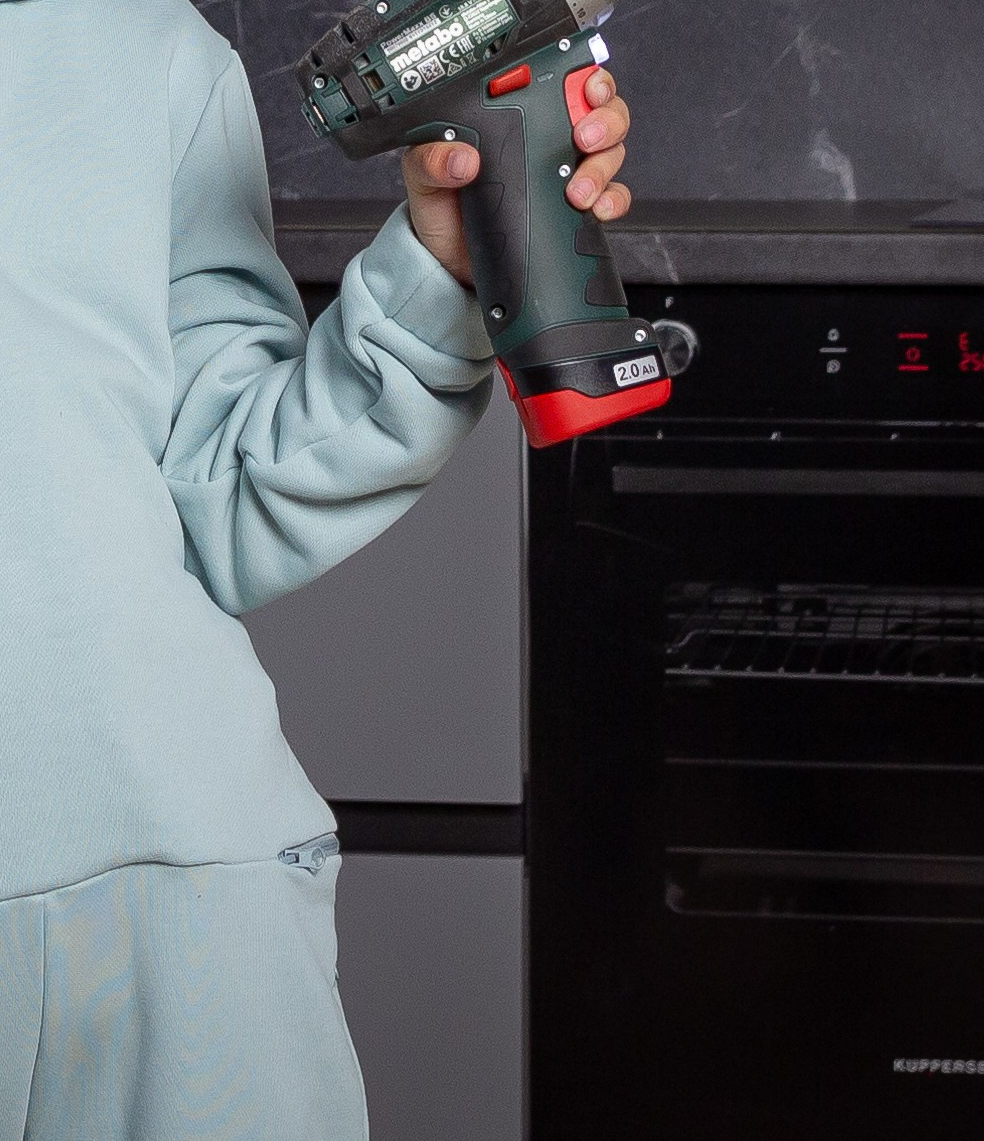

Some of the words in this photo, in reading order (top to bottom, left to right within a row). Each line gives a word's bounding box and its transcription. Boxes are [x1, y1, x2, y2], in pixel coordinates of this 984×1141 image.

[389, 21, 464, 73] metabo
[618, 363, 640, 381] 2.0
[642, 364, 656, 376] Ah
